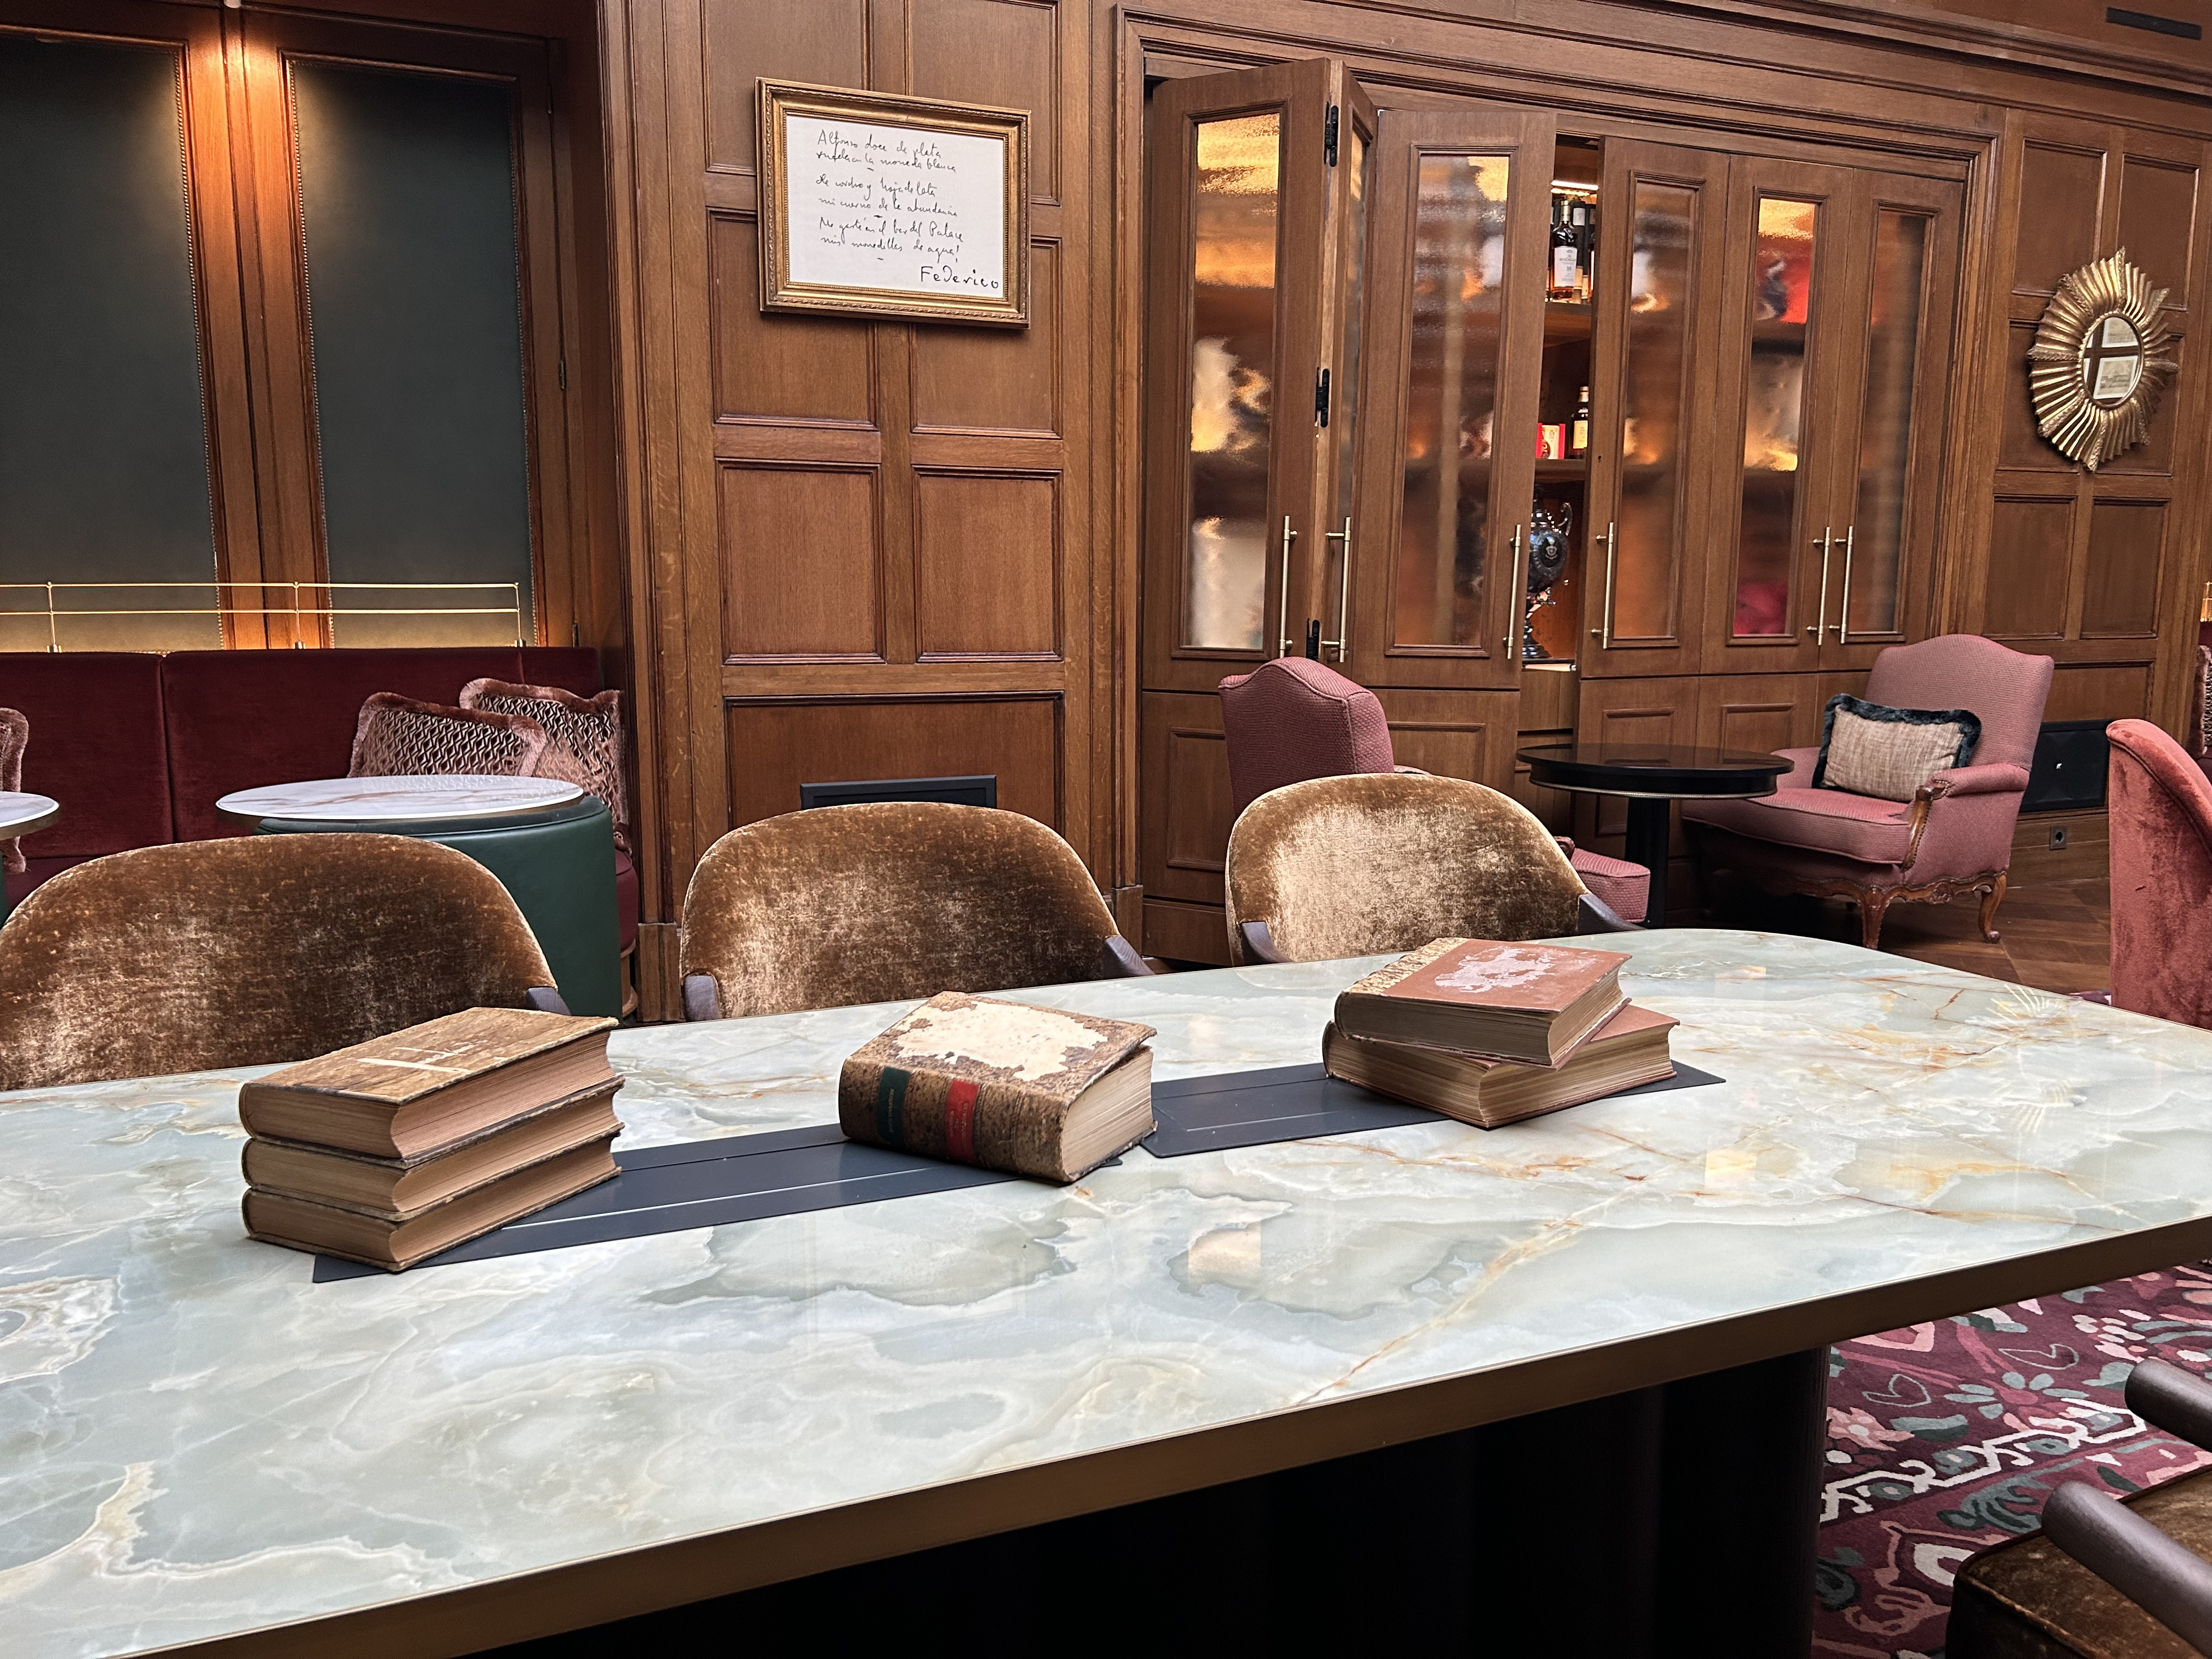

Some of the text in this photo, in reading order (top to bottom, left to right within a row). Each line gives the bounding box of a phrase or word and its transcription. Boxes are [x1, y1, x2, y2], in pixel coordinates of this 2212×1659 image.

[817, 129, 941, 164] Alfonso doce de plata
[865, 153, 874, 165] la
[880, 158, 922, 170] moneda
[927, 157, 956, 173] blanca
[863, 184, 871, 201] y
[819, 196, 957, 217] mi cuerno de la abundancia
[820, 217, 833, 229] Me
[879, 221, 887, 236] el
[894, 218, 907, 234] bar
[910, 220, 922, 237] del
[929, 221, 964, 242] Palace
[821, 235, 841, 246] mis
[851, 237, 903, 252] monedillas
[913, 239, 923, 250] de
